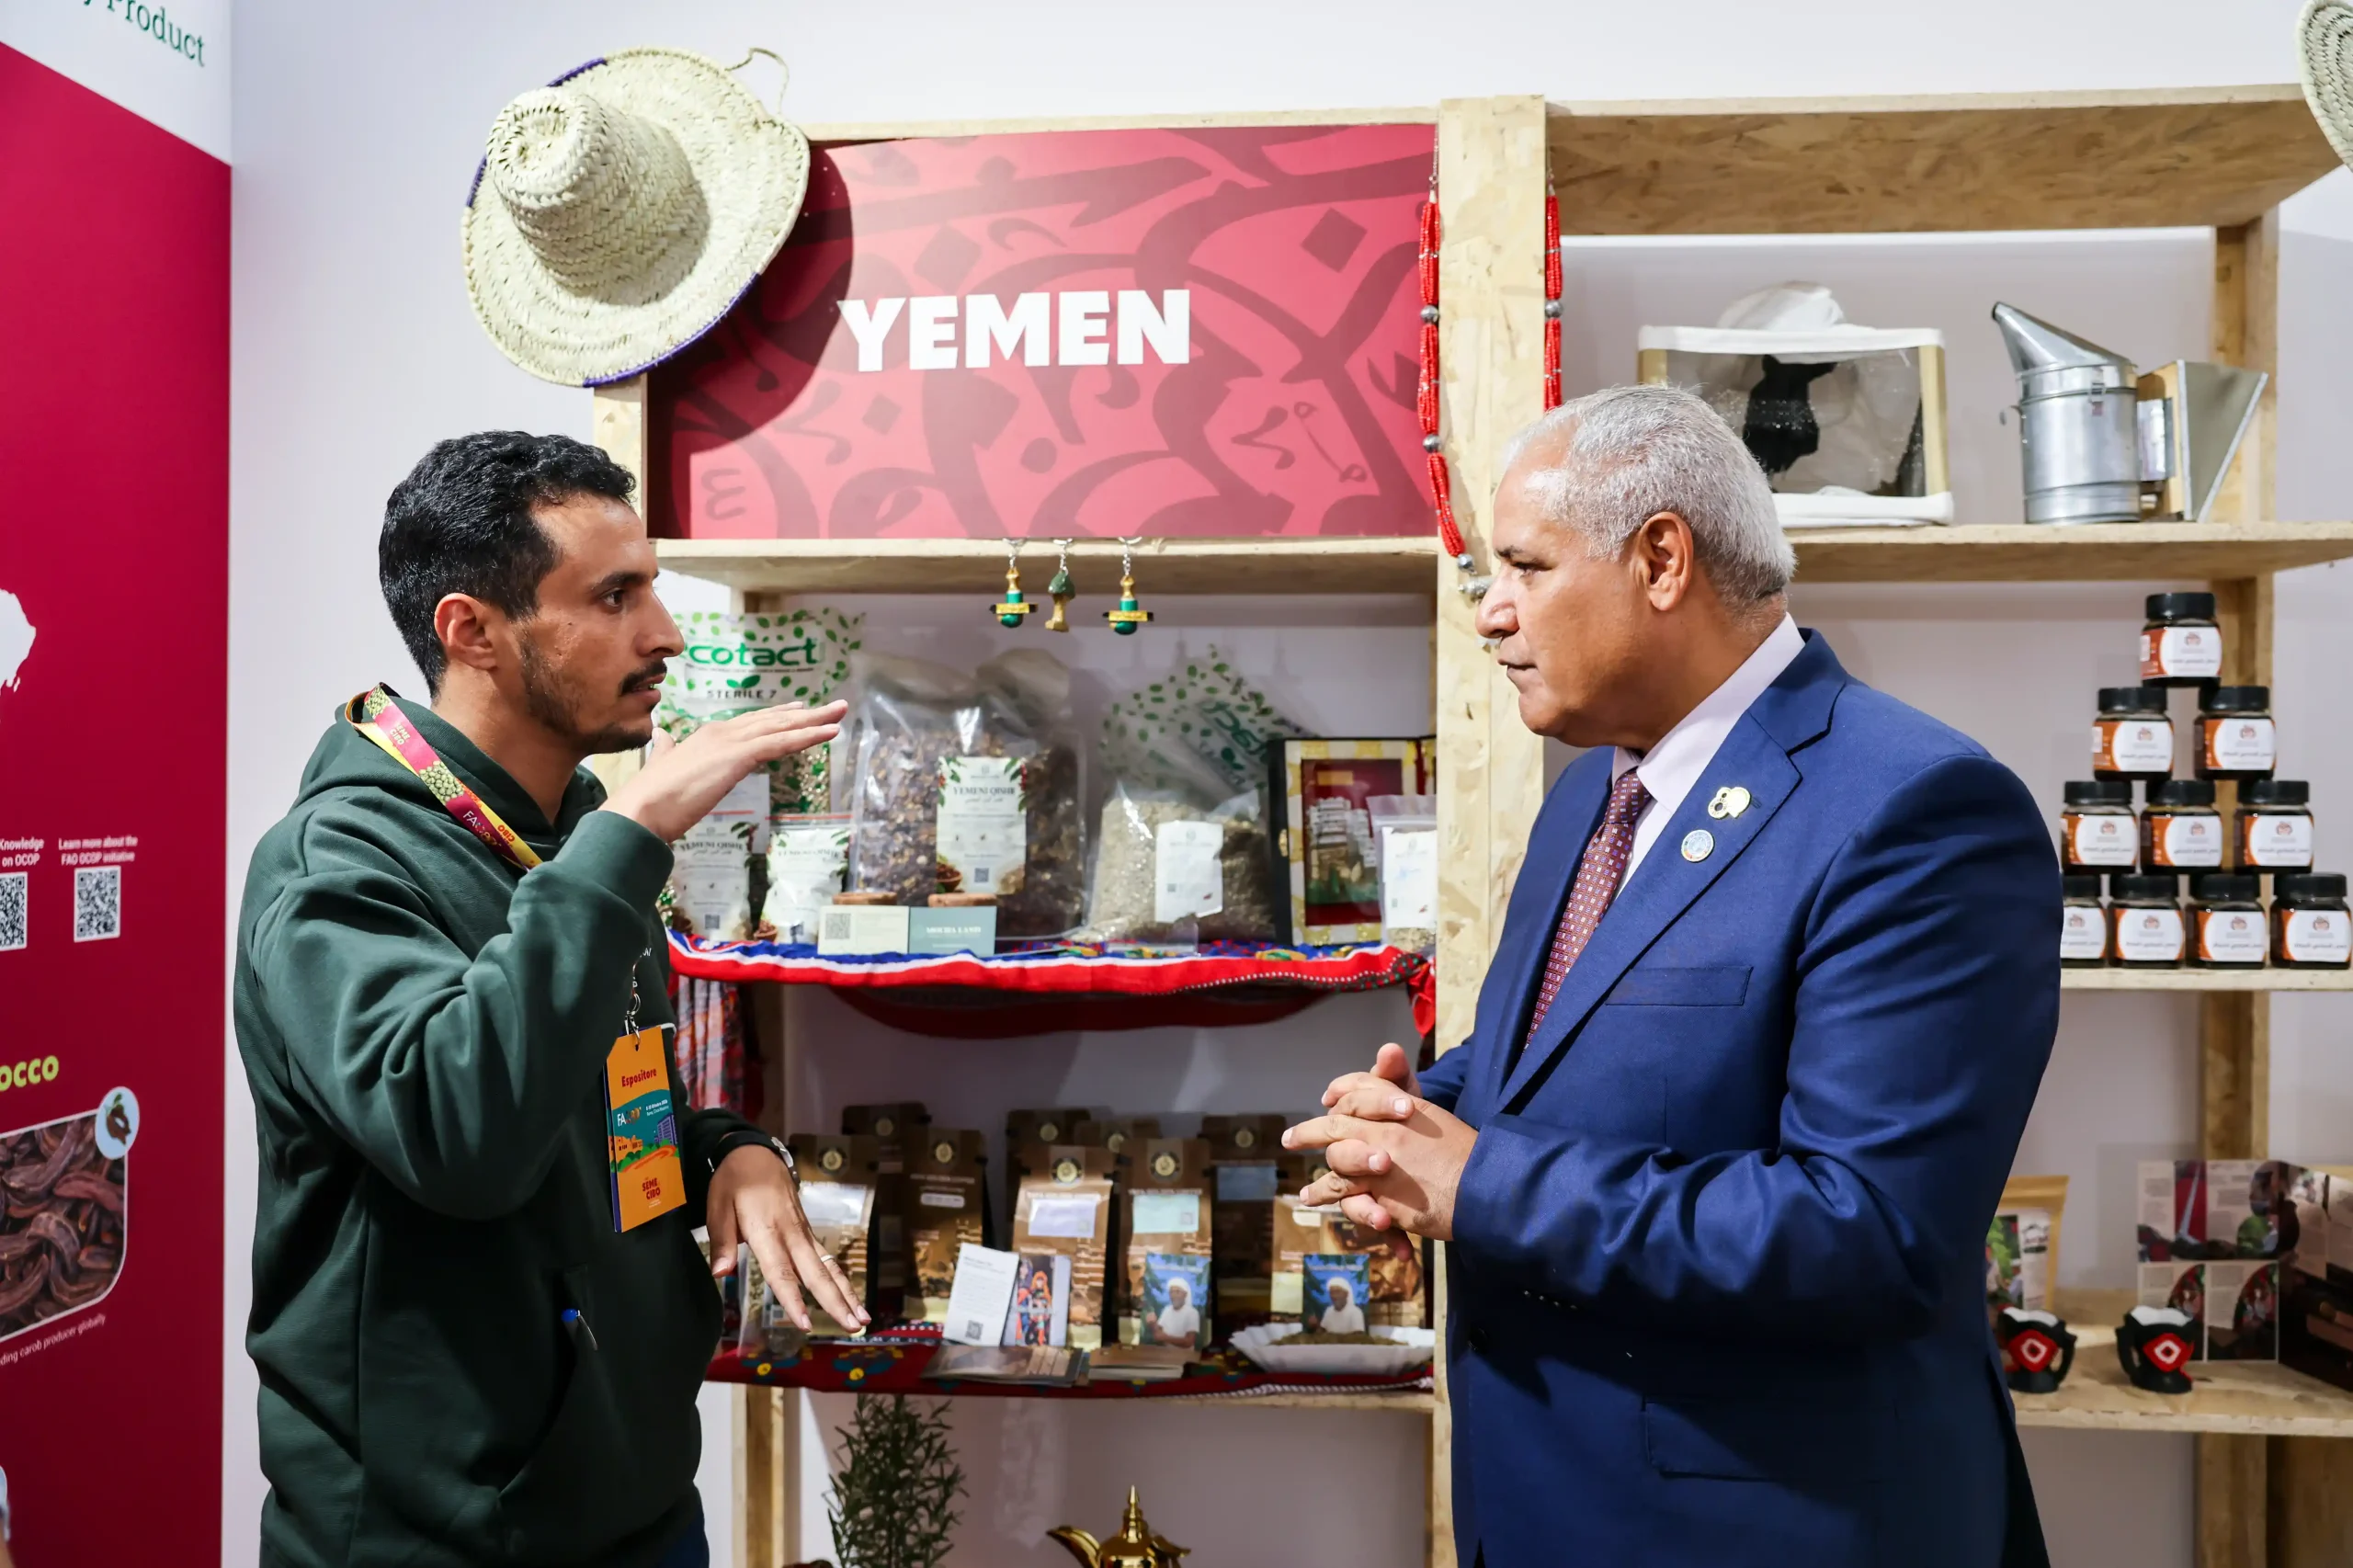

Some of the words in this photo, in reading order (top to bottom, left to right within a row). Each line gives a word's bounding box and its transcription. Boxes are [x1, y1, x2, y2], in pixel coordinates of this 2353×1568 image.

[835, 289, 1190, 372] YEMEN
[684, 637, 818, 666] cotact
[2, 856, 14, 868] on
[15, 853, 40, 867] OCOP
[61, 853, 79, 866] FAO
[621, 1068, 657, 1088] Espositore
